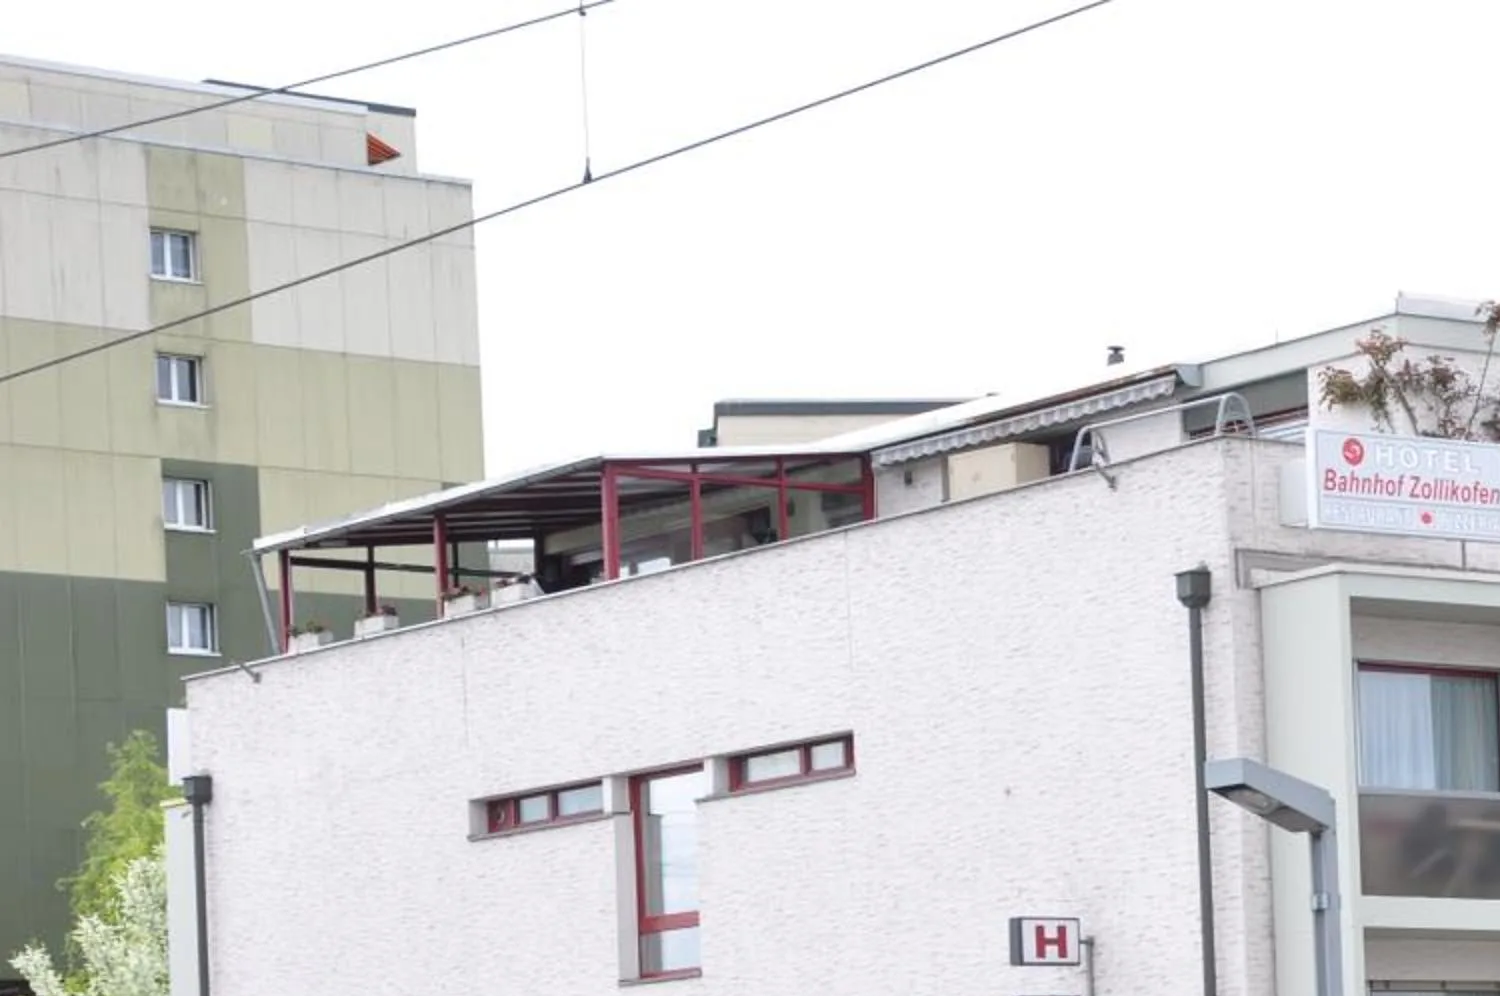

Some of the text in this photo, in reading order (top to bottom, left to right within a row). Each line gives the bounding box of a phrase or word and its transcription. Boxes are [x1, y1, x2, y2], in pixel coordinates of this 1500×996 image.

[1375, 445, 1479, 474] HOTEL
[1324, 469, 1500, 504] Bahnhof Zollikofen
